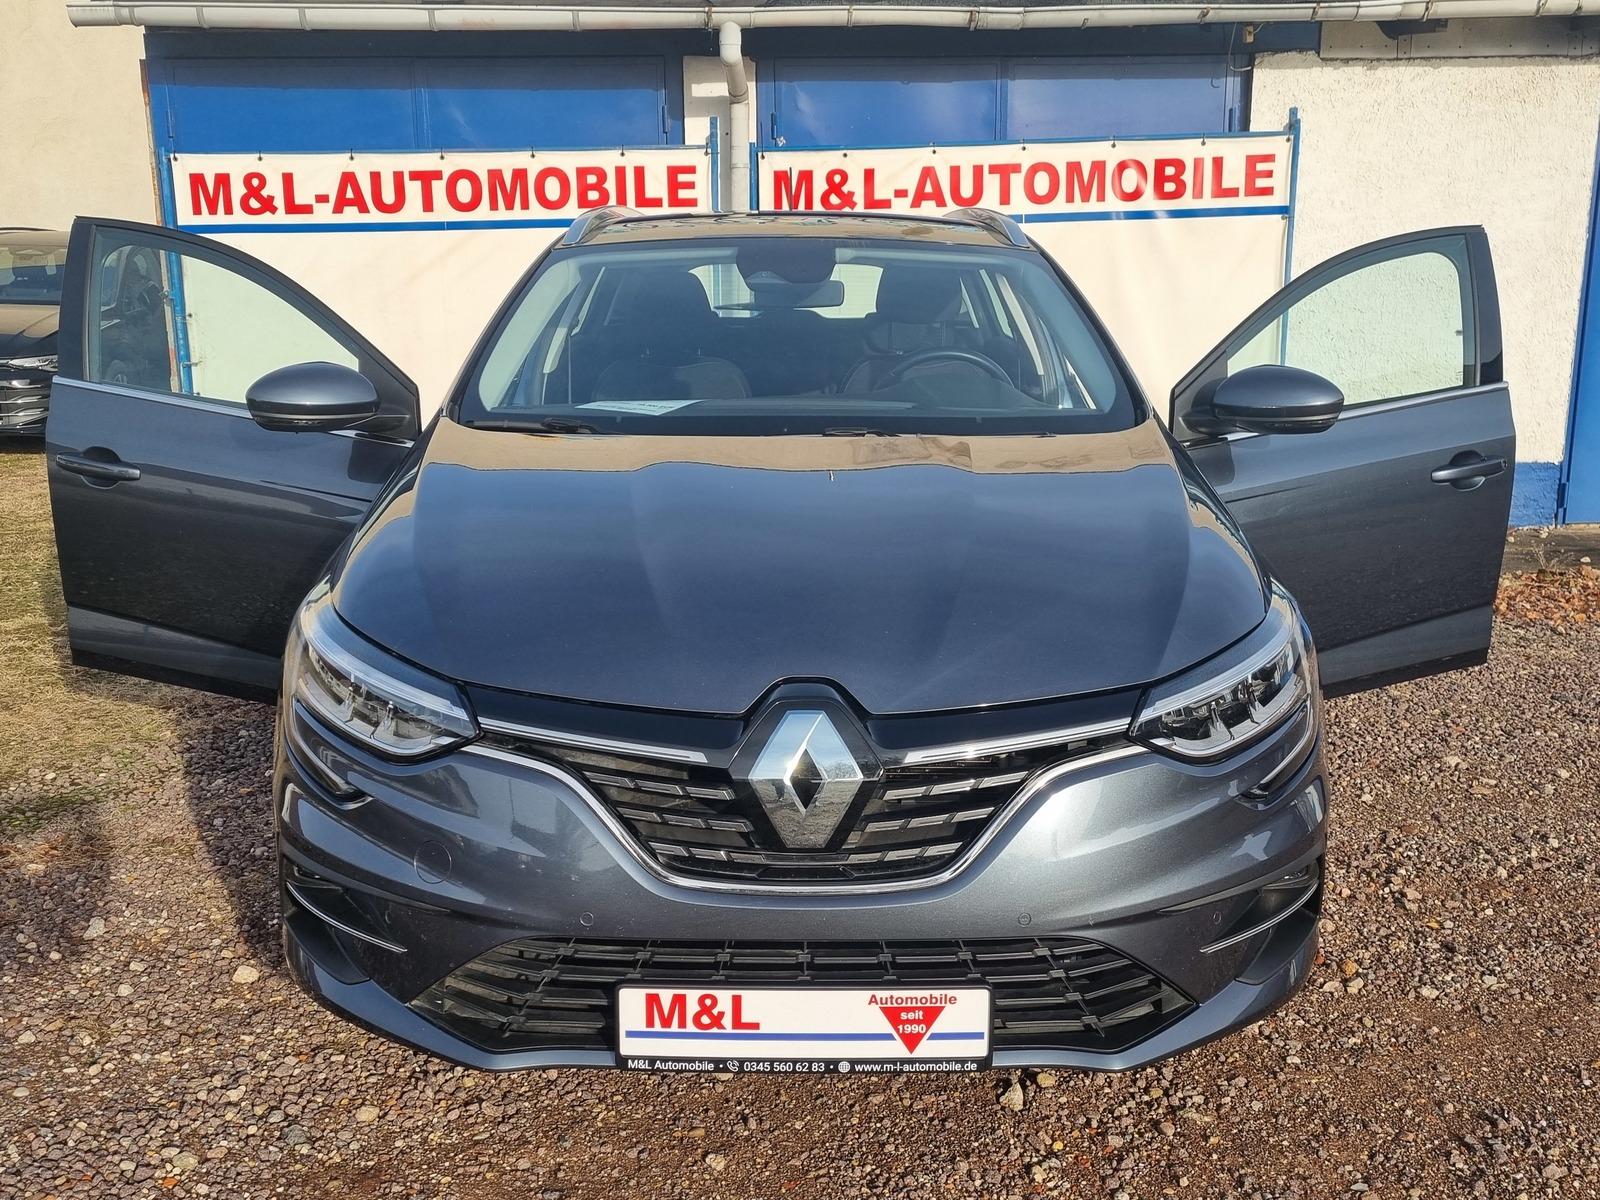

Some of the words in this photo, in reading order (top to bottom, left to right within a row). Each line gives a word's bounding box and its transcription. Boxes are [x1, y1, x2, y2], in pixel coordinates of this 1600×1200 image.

[773, 153, 1275, 211] M&L-AUTOMOBILE
[189, 165, 698, 216] M&L-AUTOMOBILE
[868, 993, 957, 1006] Automobile
[645, 993, 760, 1031] M&L
[900, 1010, 924, 1020] seit
[897, 1024, 926, 1034] 1990
[627, 1059, 651, 1070] M&L
[654, 1060, 715, 1071] Automobile
[743, 1062, 771, 1072] 0345
[773, 1062, 793, 1072] 560
[795, 1062, 809, 1072] 62
[811, 1062, 825, 1072] 83
[854, 1061, 978, 1072] www.m-l-automobile.de
